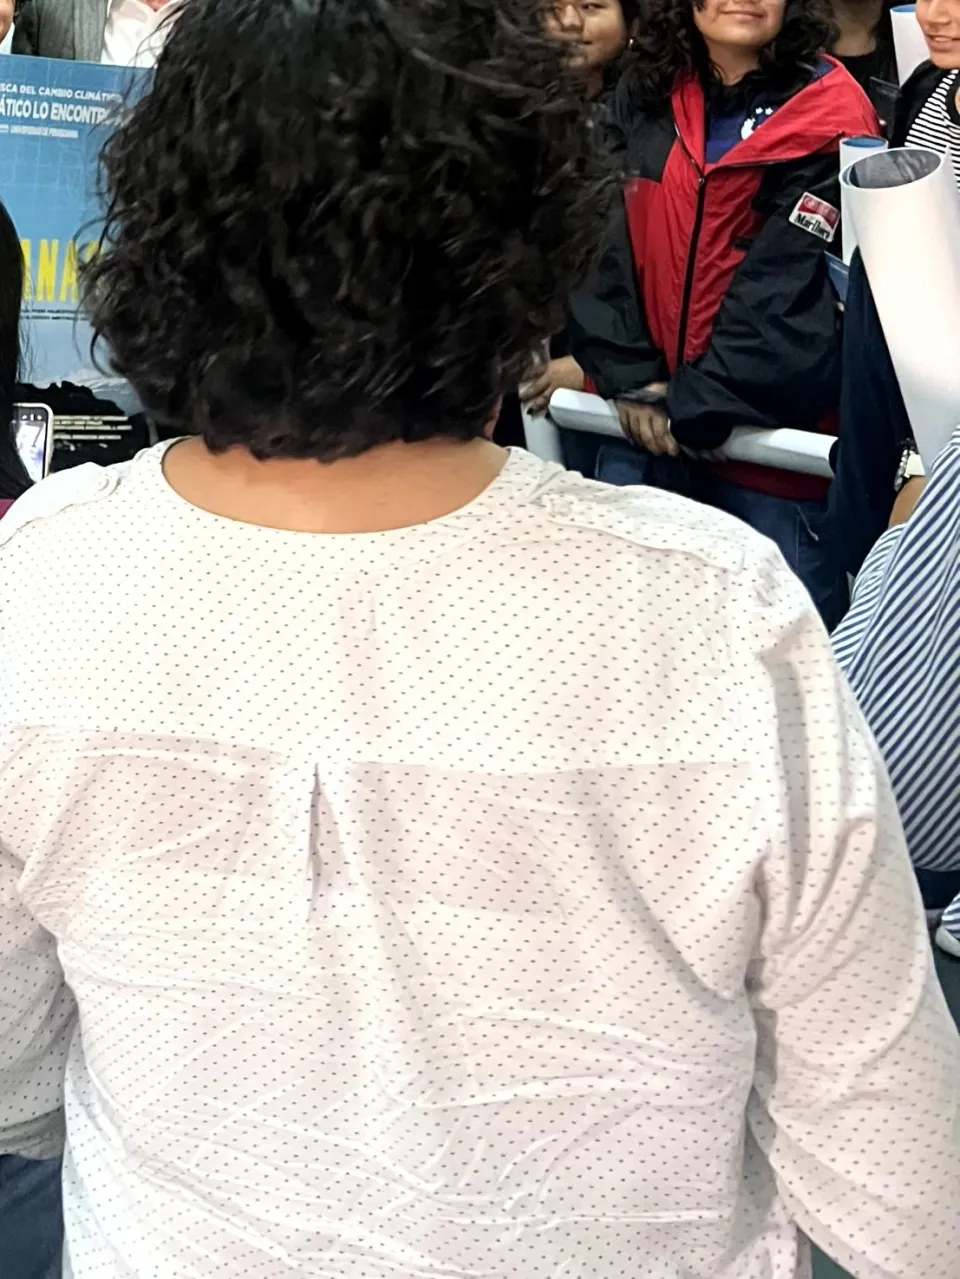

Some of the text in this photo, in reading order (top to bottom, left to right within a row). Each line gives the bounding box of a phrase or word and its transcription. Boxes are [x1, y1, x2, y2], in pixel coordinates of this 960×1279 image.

[20, 84, 37, 95] DEL
[38, 86, 73, 99] CAMBIO
[32, 100, 50, 120] LO
[50, 102, 110, 125] ENCONTR
